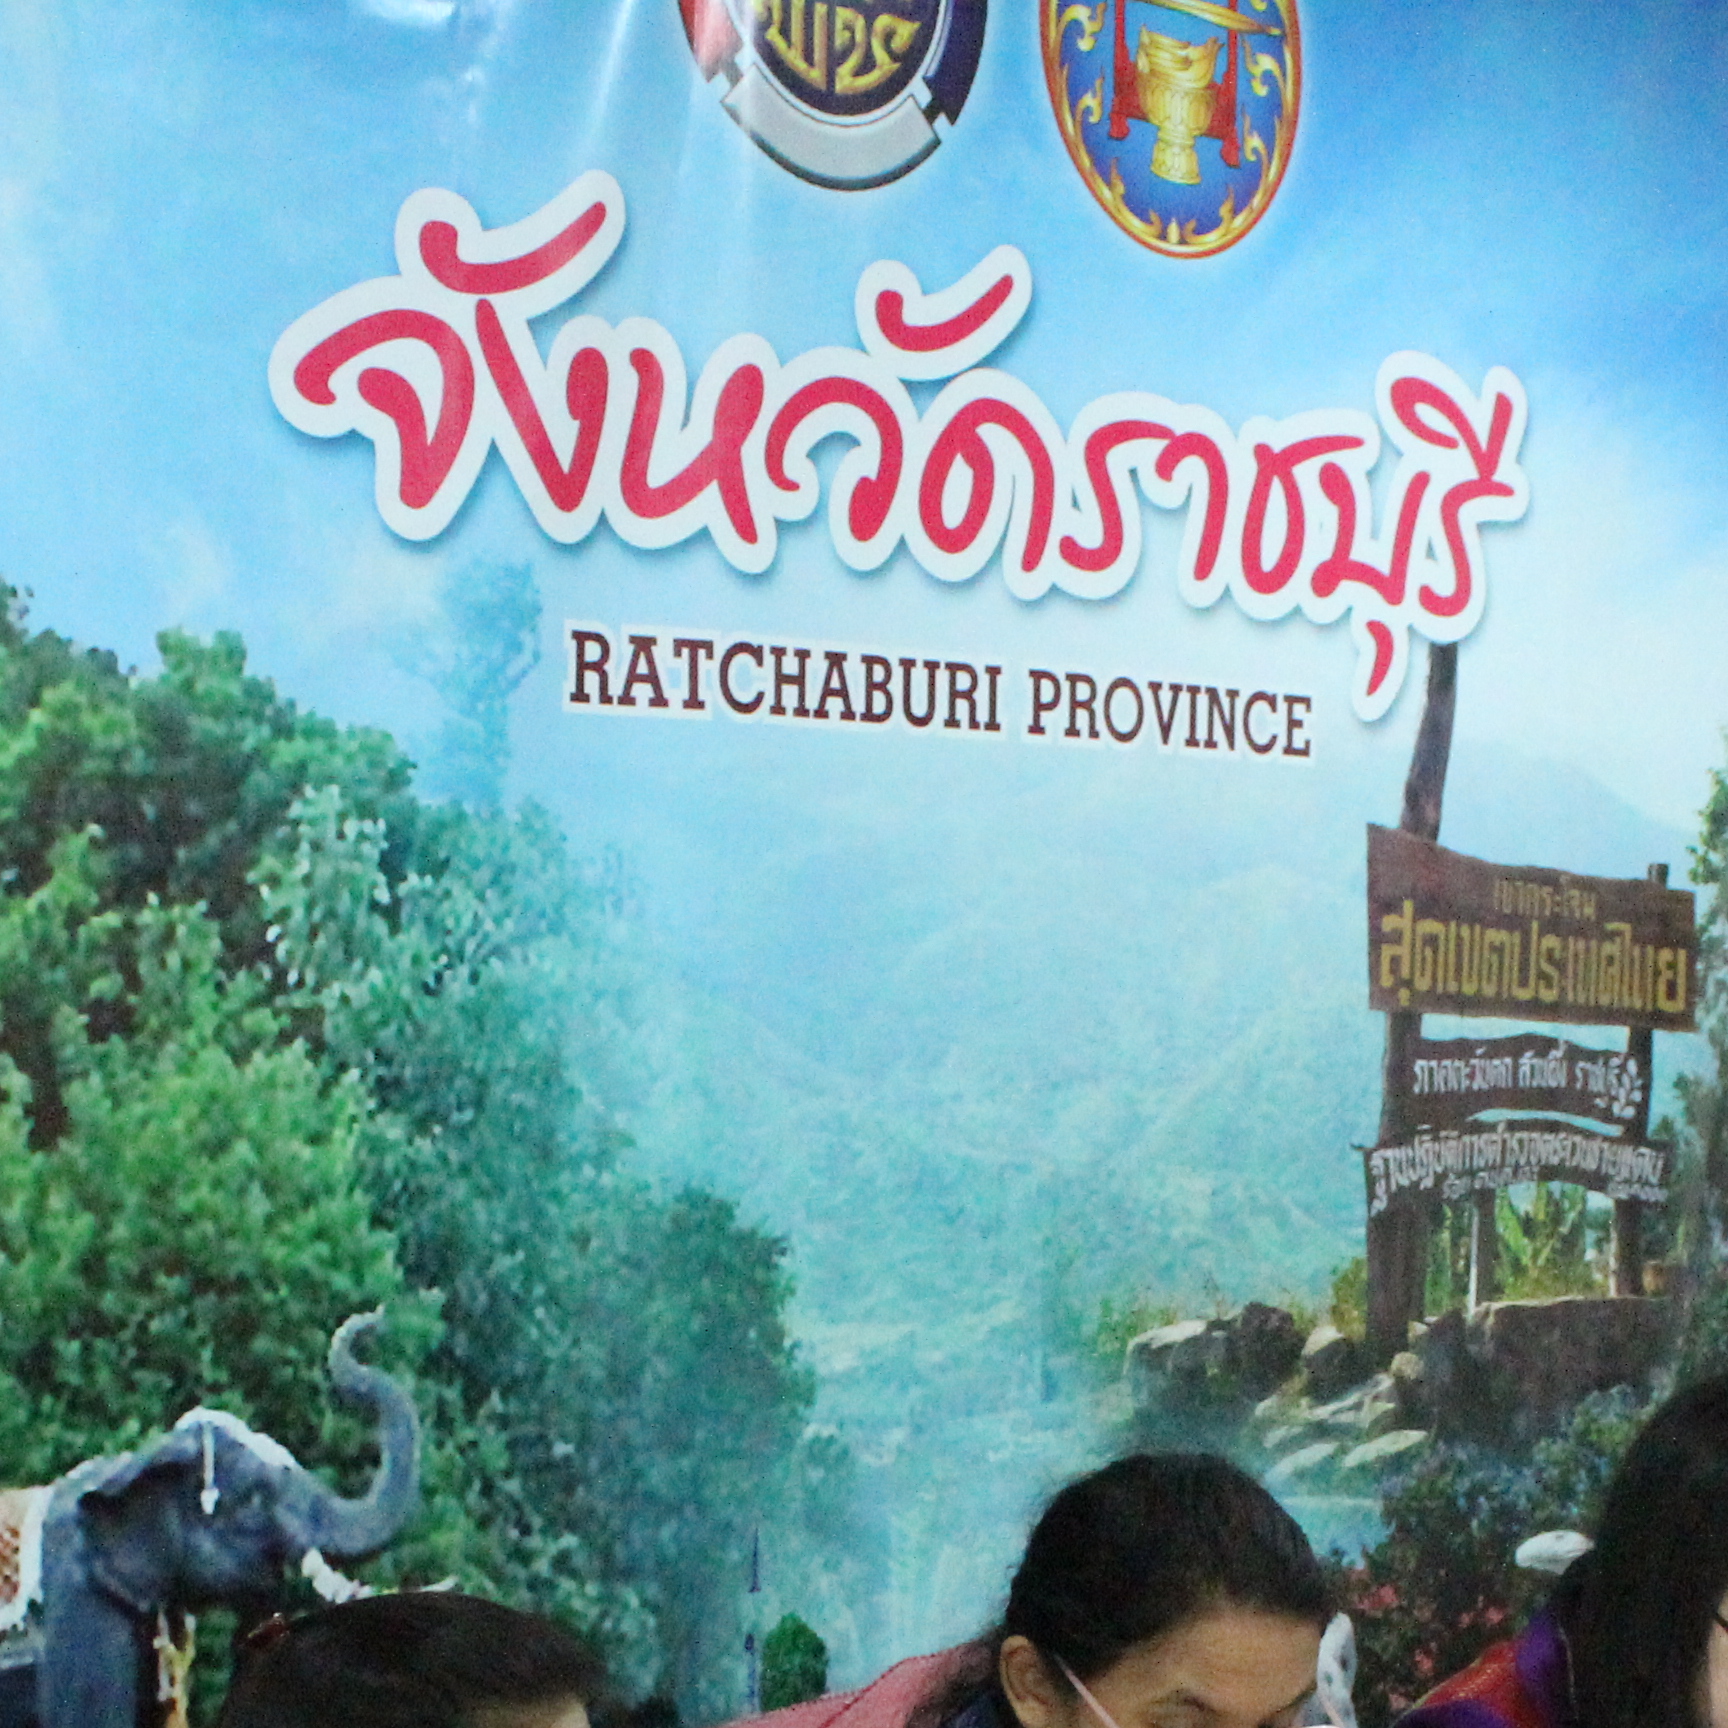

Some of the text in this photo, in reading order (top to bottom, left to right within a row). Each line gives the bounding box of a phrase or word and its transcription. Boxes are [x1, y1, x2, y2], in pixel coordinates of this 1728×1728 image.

[290, 198, 1518, 700] จังหวัดราชบุรี
[569, 629, 1313, 758] RATCHABURI PROVINCE
[1380, 898, 1687, 1013] สุดเขตประเทศไทย
